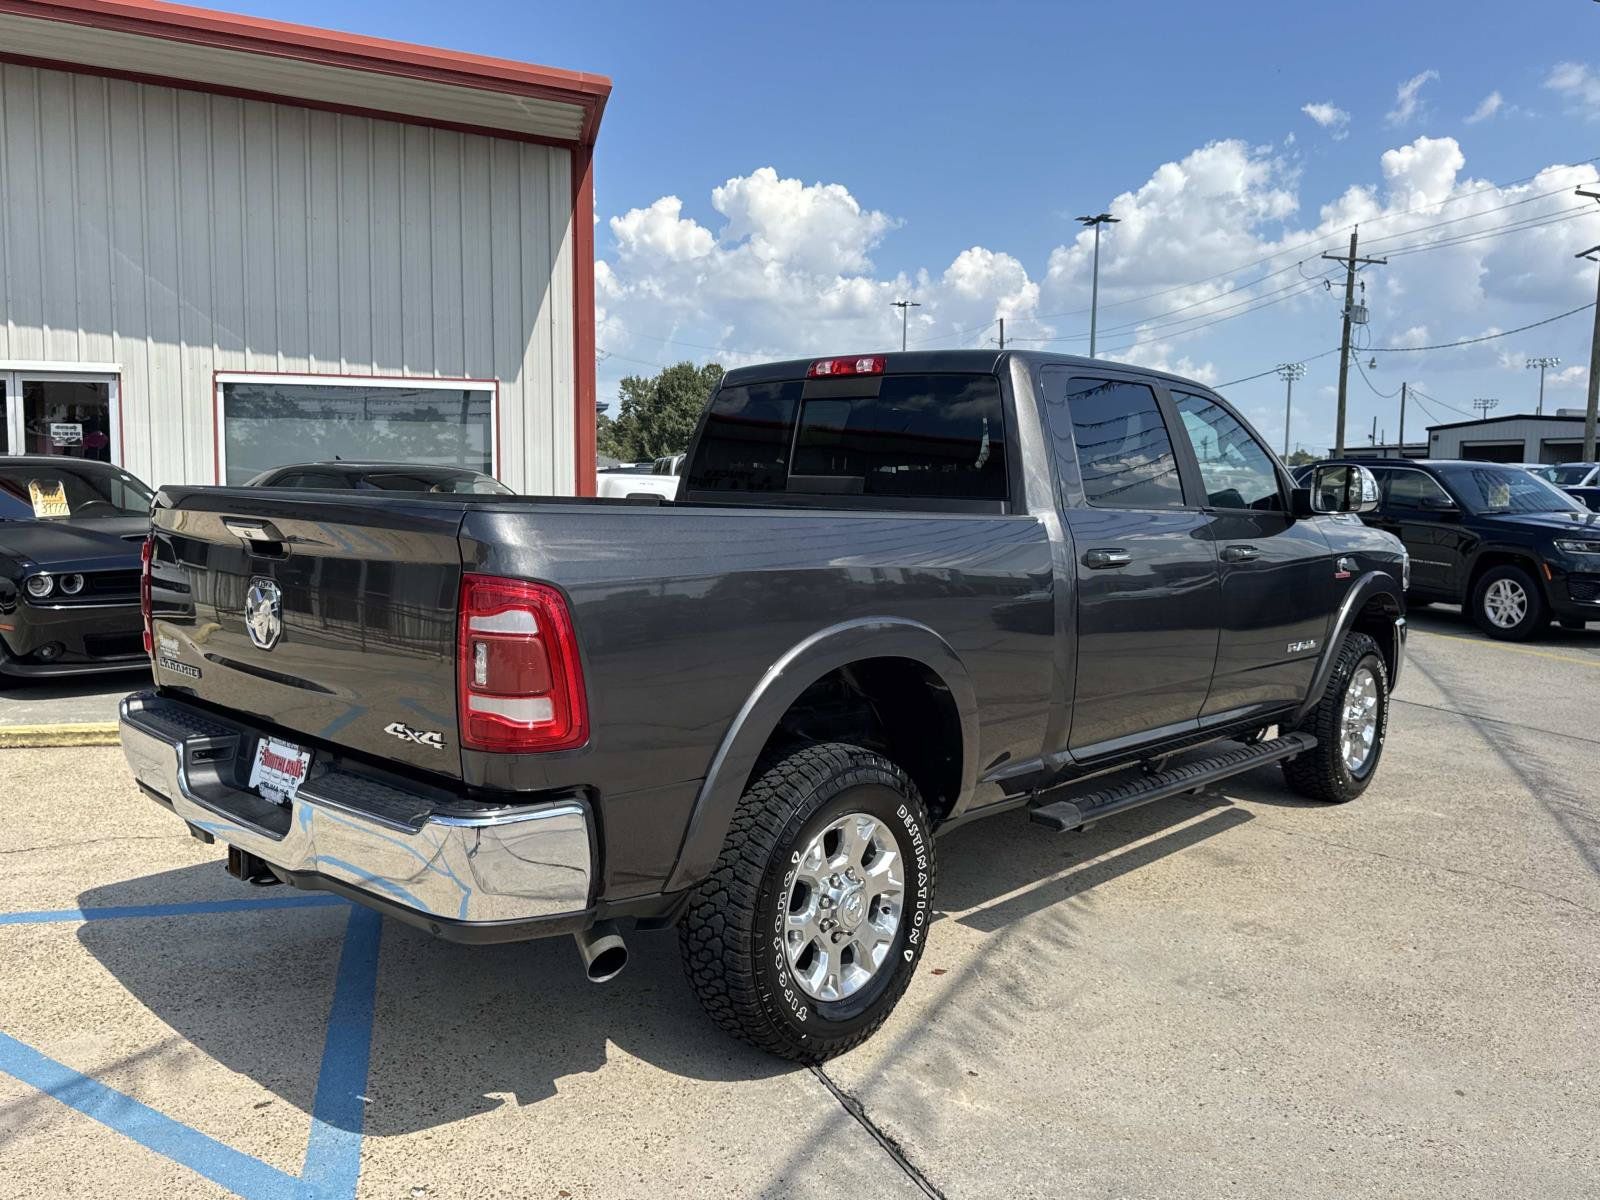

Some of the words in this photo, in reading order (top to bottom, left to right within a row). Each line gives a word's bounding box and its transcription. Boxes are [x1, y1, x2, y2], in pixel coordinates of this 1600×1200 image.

[160, 657, 201, 679] LARAMIE
[262, 746, 303, 780] SOUTHLAND
[896, 804, 928, 944] DESTINATION
